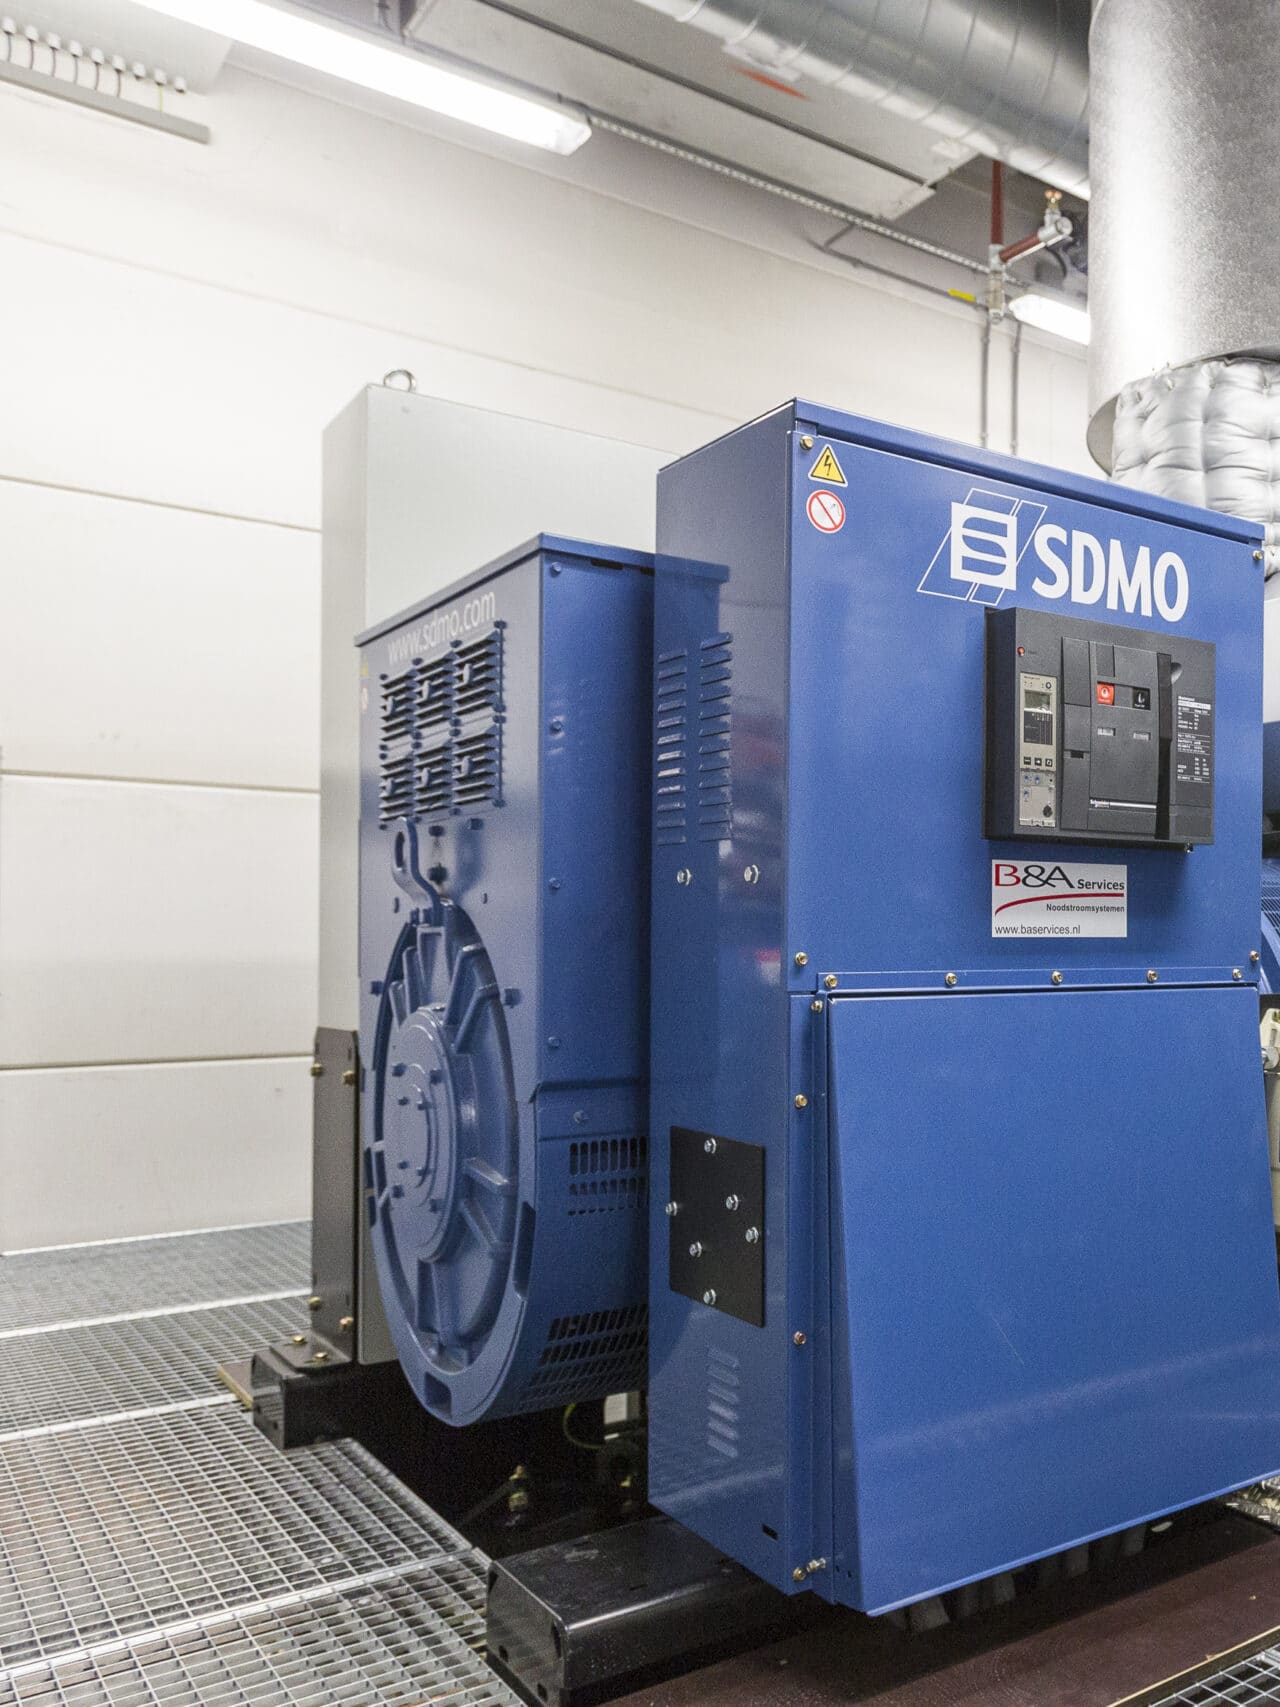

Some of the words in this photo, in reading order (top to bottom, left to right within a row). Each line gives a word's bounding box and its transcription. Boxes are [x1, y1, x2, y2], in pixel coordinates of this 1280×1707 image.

[1032, 523, 1190, 622] SDMO
[388, 591, 496, 665] www.sdmo.com
[994, 863, 1075, 888] B&A
[1077, 878, 1125, 891] Services
[1046, 903, 1125, 913] Noodstroomsystemen
[995, 924, 1081, 935] www.baservices.nl
